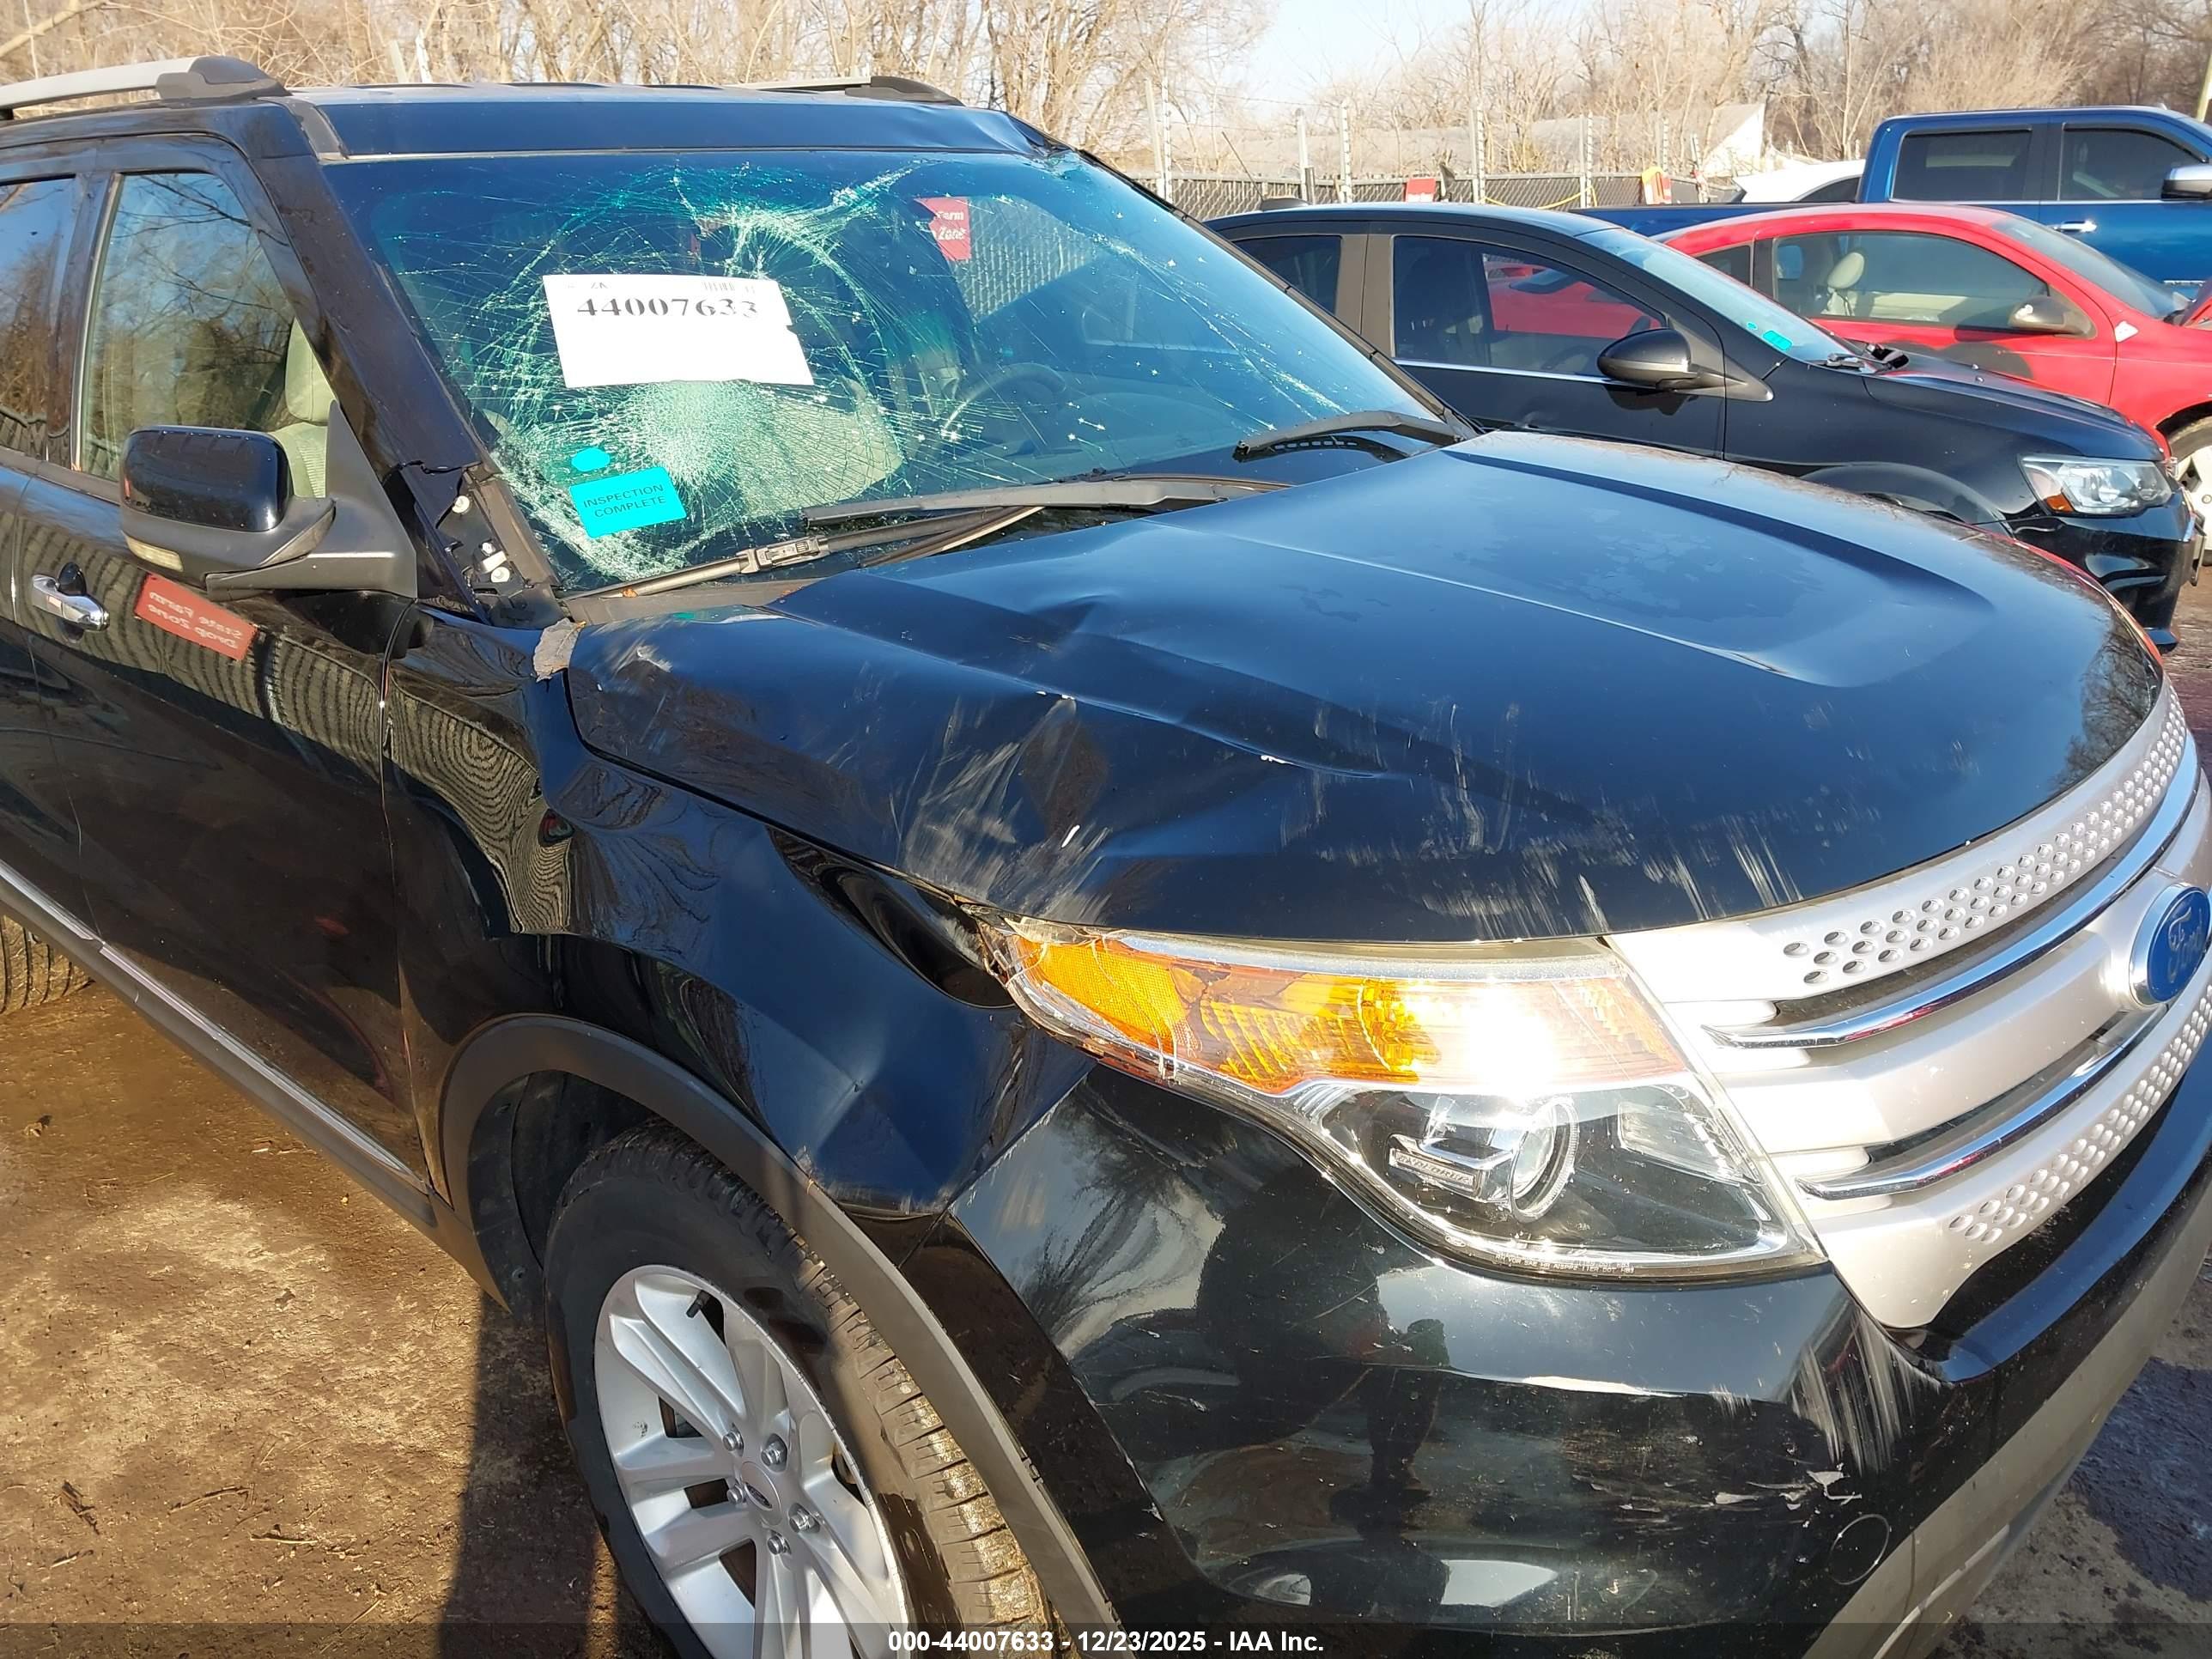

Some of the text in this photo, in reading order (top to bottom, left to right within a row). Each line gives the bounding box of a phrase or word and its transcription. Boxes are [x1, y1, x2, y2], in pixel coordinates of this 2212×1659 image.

[577, 298, 757, 318] 44007633
[583, 483, 664, 508] INSPECTION
[594, 495, 666, 518] COMPLETE
[2168, 906, 2205, 983] Ford
